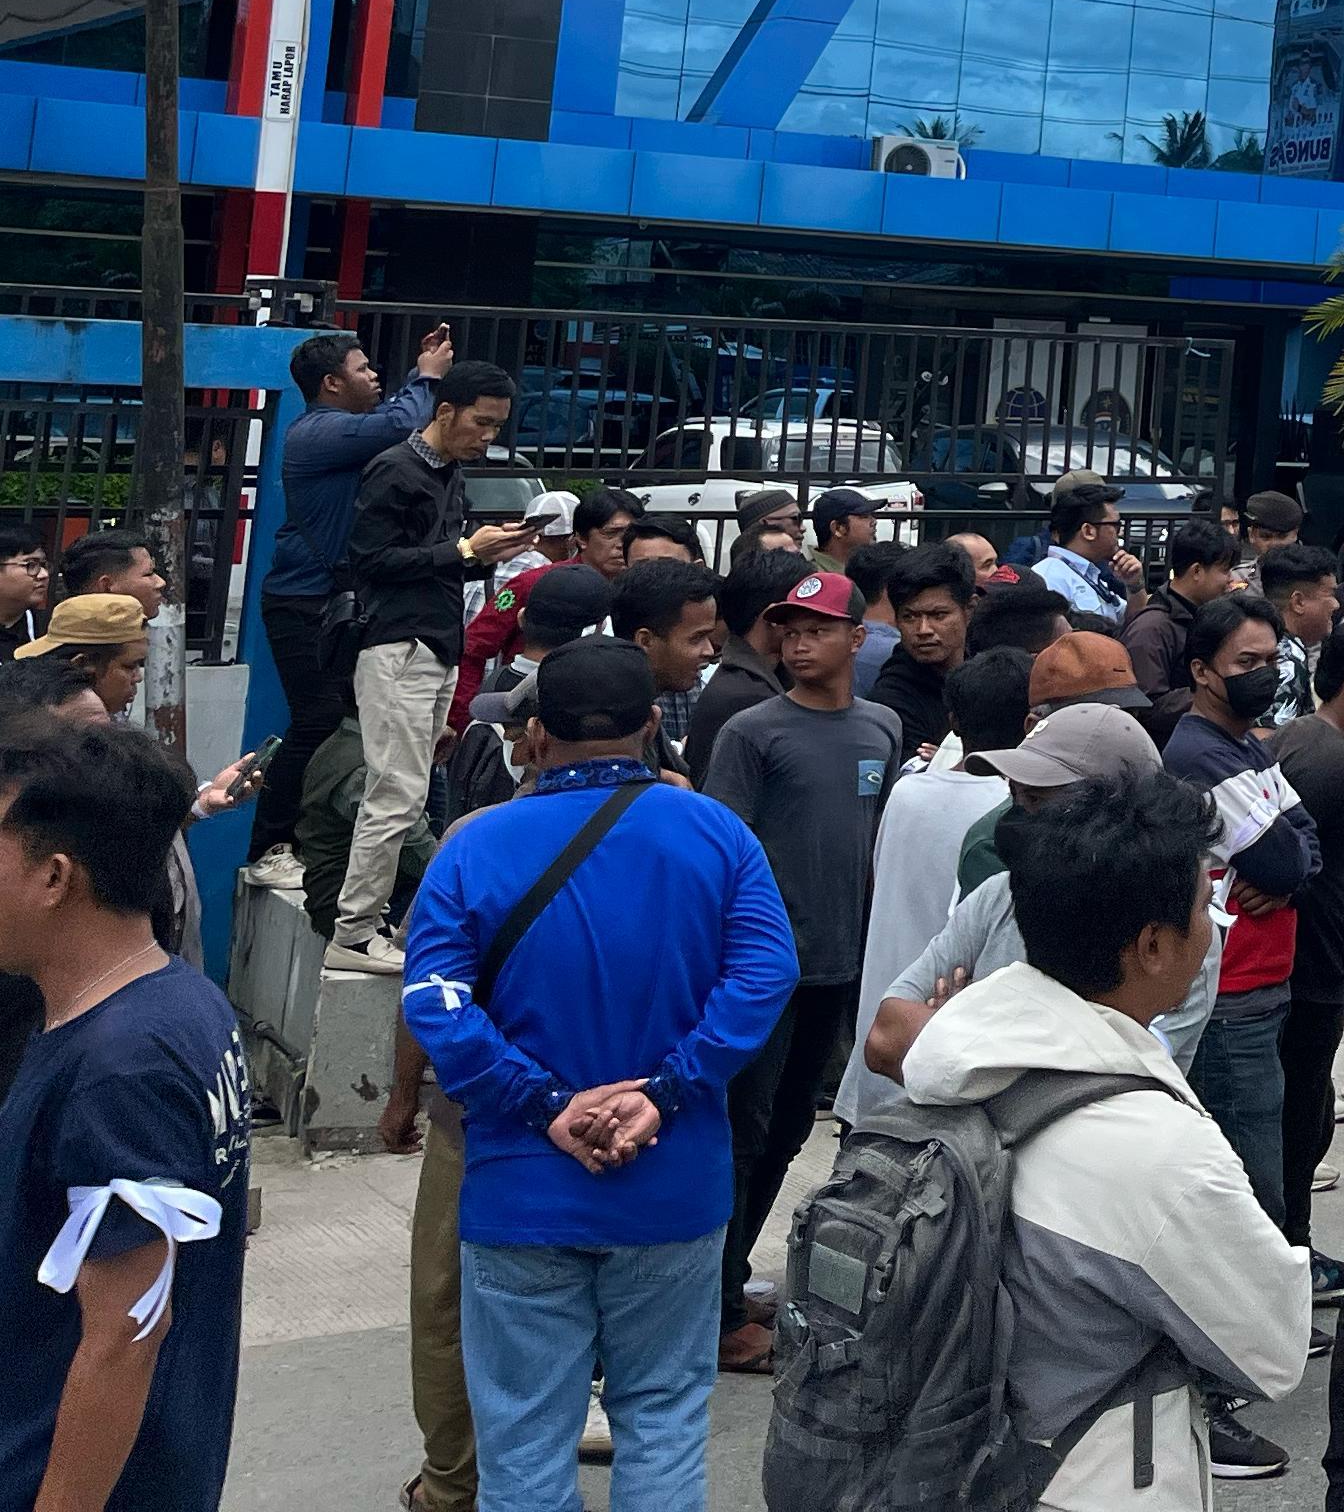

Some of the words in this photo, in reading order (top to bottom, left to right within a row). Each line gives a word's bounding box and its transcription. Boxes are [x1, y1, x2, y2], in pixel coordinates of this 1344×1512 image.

[270, 61, 283, 98] TAMU
[283, 46, 296, 78] LAPOR
[280, 80, 292, 115] HARAP
